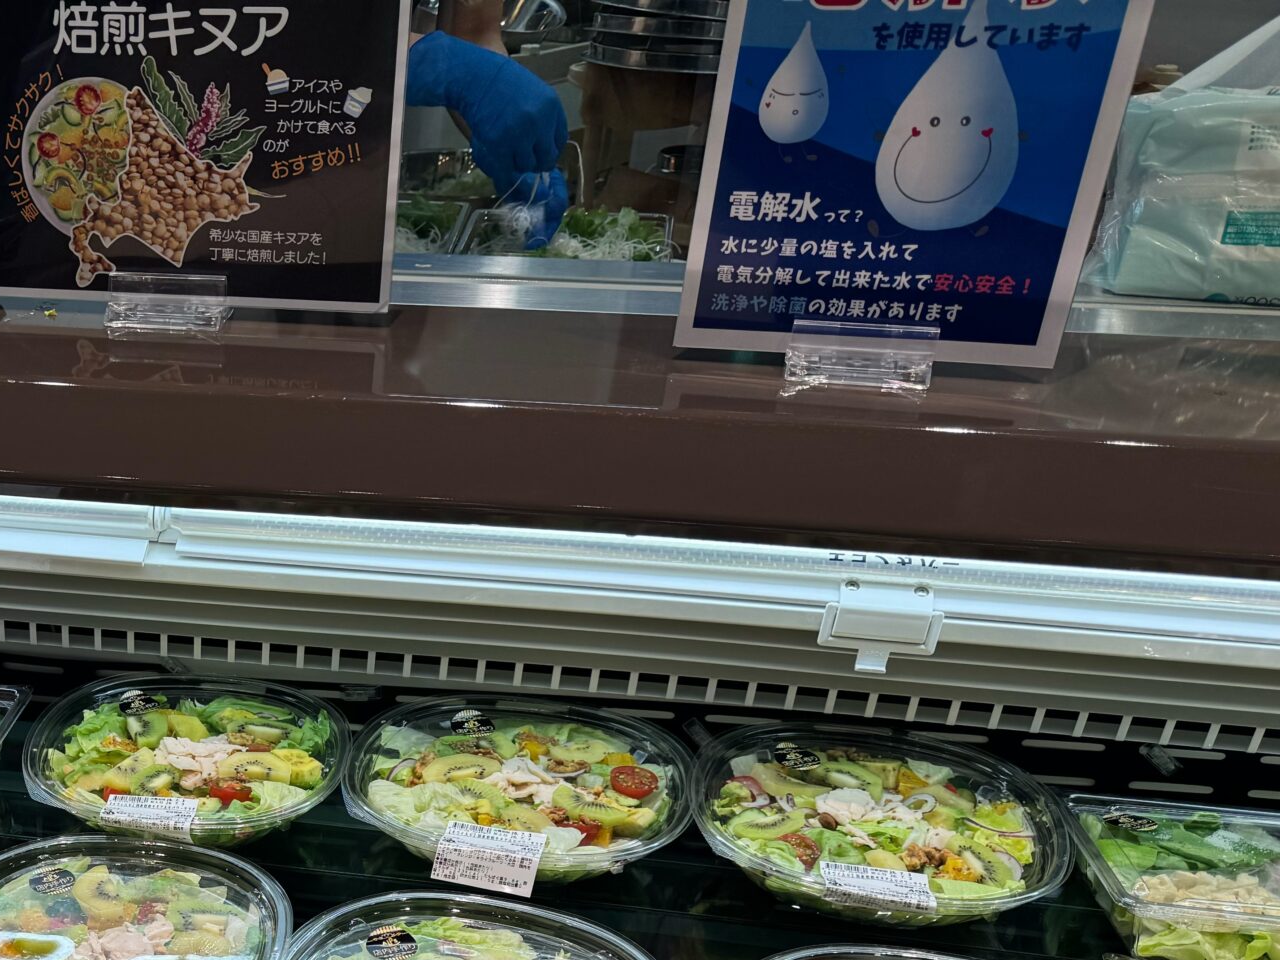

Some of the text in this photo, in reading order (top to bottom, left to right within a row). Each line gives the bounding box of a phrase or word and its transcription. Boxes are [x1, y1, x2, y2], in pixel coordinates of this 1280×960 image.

[53, 1, 289, 56] 焙煎キヌア
[872, 22, 1091, 52] を使用しています
[291, 79, 343, 94] アイスや
[264, 99, 342, 114] ヨーグルトに
[277, 120, 357, 135] かけて食べる
[262, 139, 290, 153] のが
[728, 191, 822, 223] 電解水
[209, 229, 323, 246] 希少な国産キヌアを
[209, 248, 327, 265] 丁寧に焙煎しました!
[719, 237, 919, 261] 水に少量の塩を入れて
[711, 293, 964, 323] 洗浄や除菌の効果があります
